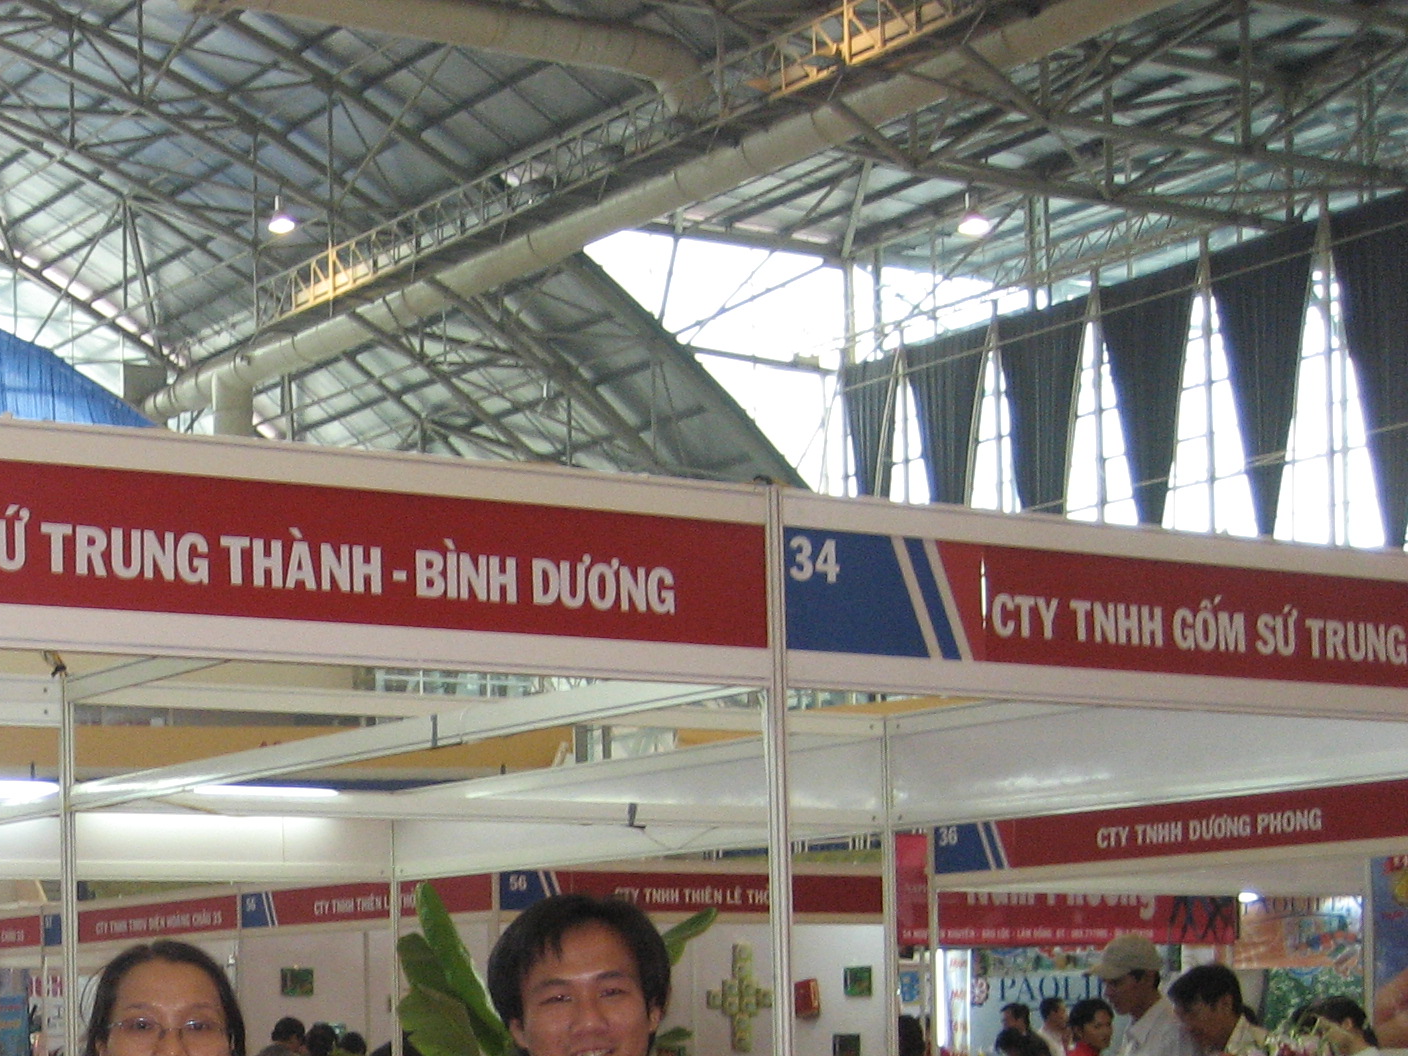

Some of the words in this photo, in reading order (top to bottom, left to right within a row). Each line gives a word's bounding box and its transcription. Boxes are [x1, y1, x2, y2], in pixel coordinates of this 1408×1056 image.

[40, 521, 210, 585] TRUNG
[532, 553, 675, 615] DƯƠNG
[789, 535, 841, 584] 34
[992, 593, 1059, 640] CTY
[1070, 600, 1163, 647] TNHH
[1172, 595, 1246, 653] GỐM
[1255, 604, 1297, 656] SỨ
[1304, 618, 1407, 665] TRUNG
[938, 826, 958, 846] 36
[1096, 827, 1128, 848] CTY
[1135, 821, 1183, 845] TNHH
[1256, 807, 1323, 835] PHONG
[644, 888, 679, 905] TNHH
